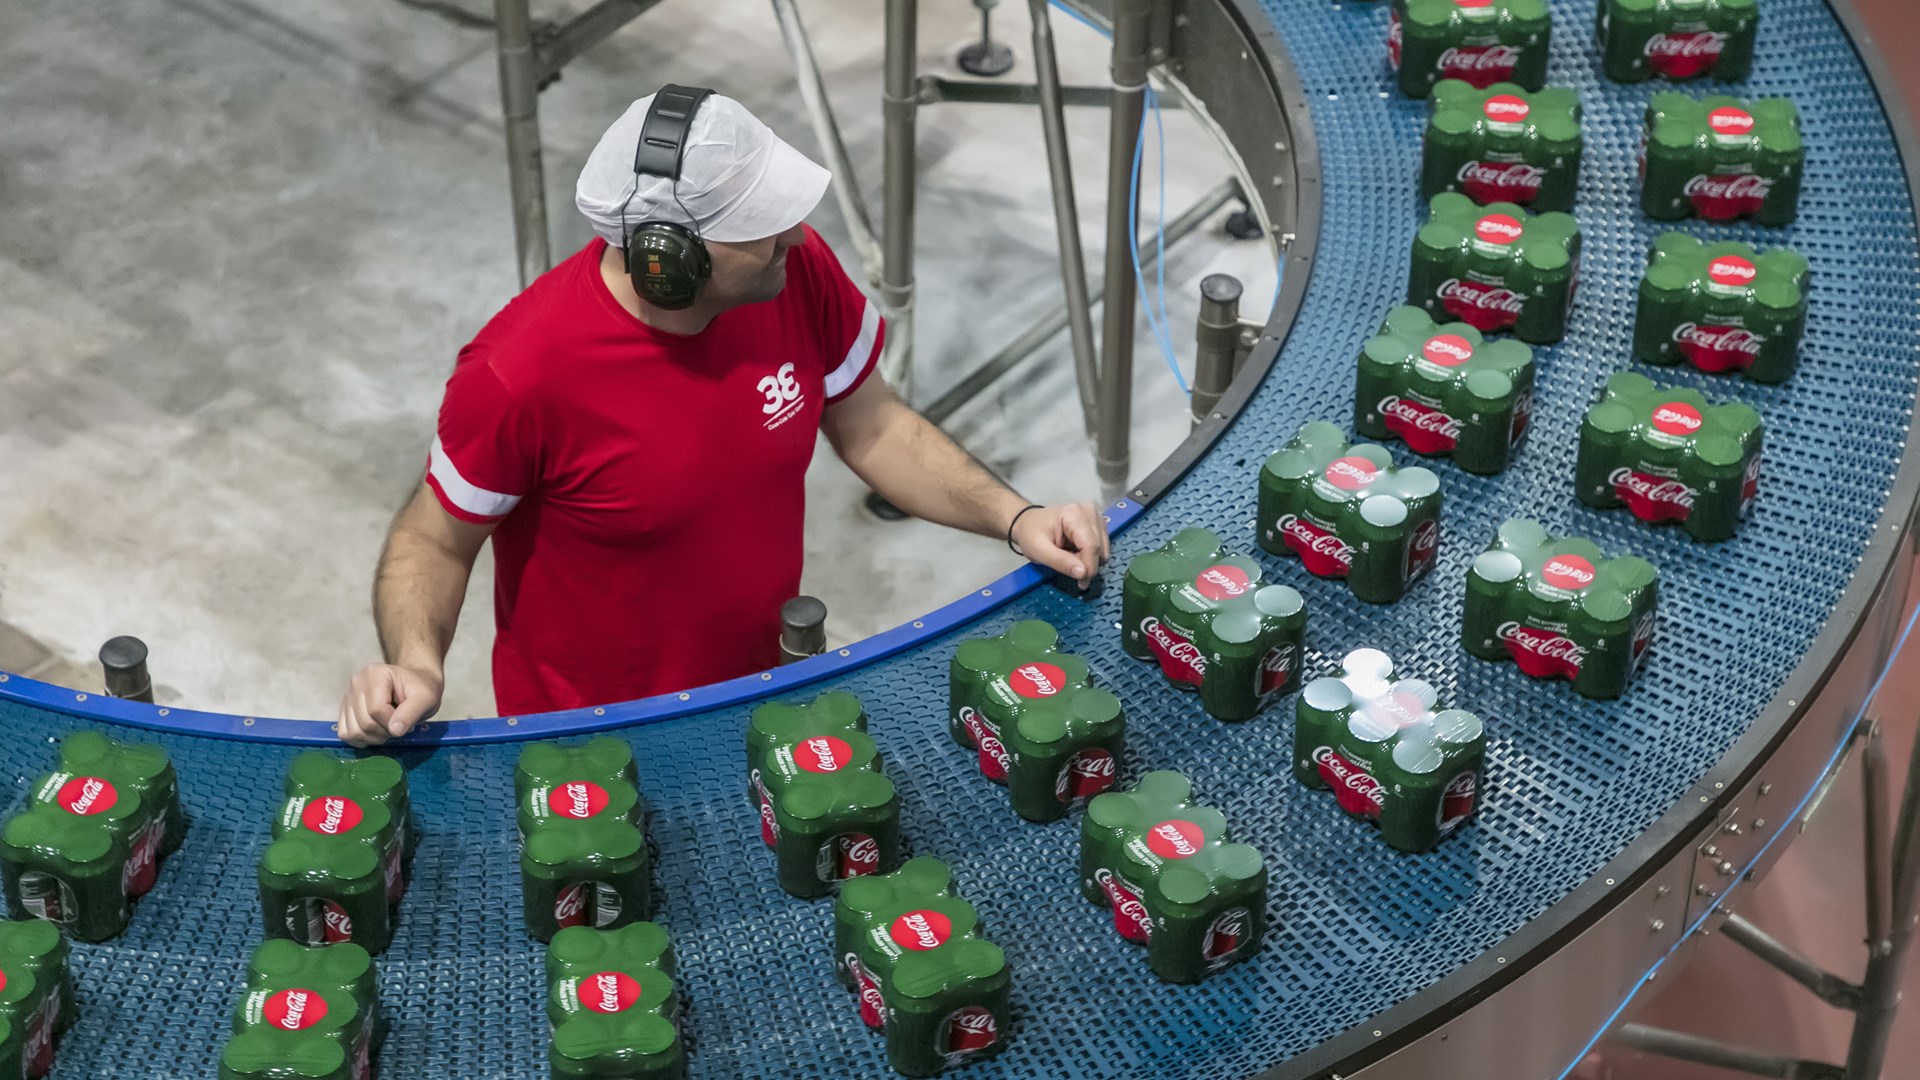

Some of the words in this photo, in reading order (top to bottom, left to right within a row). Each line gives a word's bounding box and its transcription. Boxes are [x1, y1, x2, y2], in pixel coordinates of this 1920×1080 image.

[1437, 278, 1529, 312] Coca-Cola
[1673, 322, 1767, 353] Coca-Cola
[1378, 395, 1466, 440] Coca-Cola
[1608, 467, 1700, 507] Coca-Cola
[1276, 514, 1354, 565] Coca-Cola
[1140, 616, 1207, 675] Coca-Cola
[1496, 621, 1587, 667] Coca-Cola
[959, 706, 1010, 772] Coca-Cola
[1312, 746, 1387, 807] Coca-Cola
[1095, 868, 1153, 936] Coca-Cola
